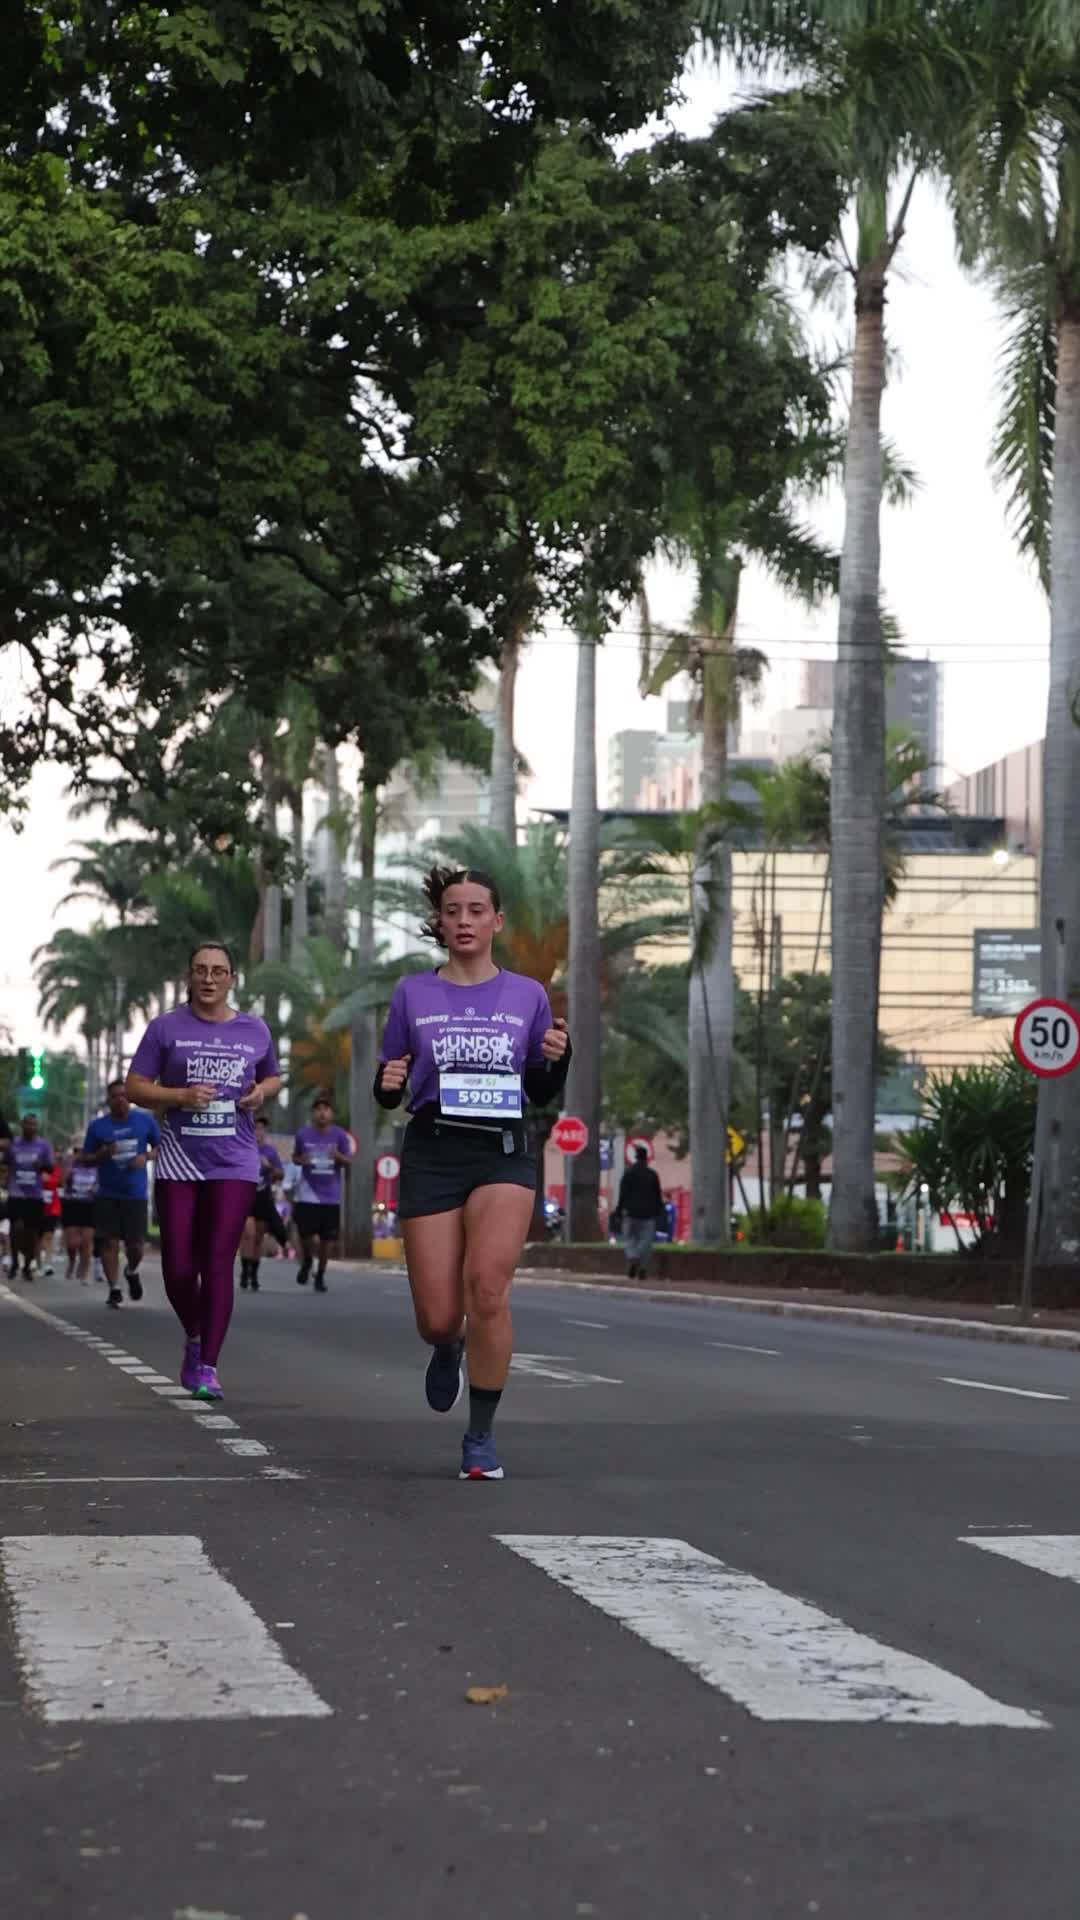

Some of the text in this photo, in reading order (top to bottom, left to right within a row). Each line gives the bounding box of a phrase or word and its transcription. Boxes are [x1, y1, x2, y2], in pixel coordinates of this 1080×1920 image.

[1030, 1016, 1070, 1048] 50
[431, 1034, 502, 1053] MUNDO
[433, 1047, 503, 1065] MELHOR
[1034, 1051, 1063, 1060] km/h
[186, 1057, 240, 1071] MUNDO
[458, 1090, 503, 1104] 5905
[192, 1113, 224, 1124] 6535
